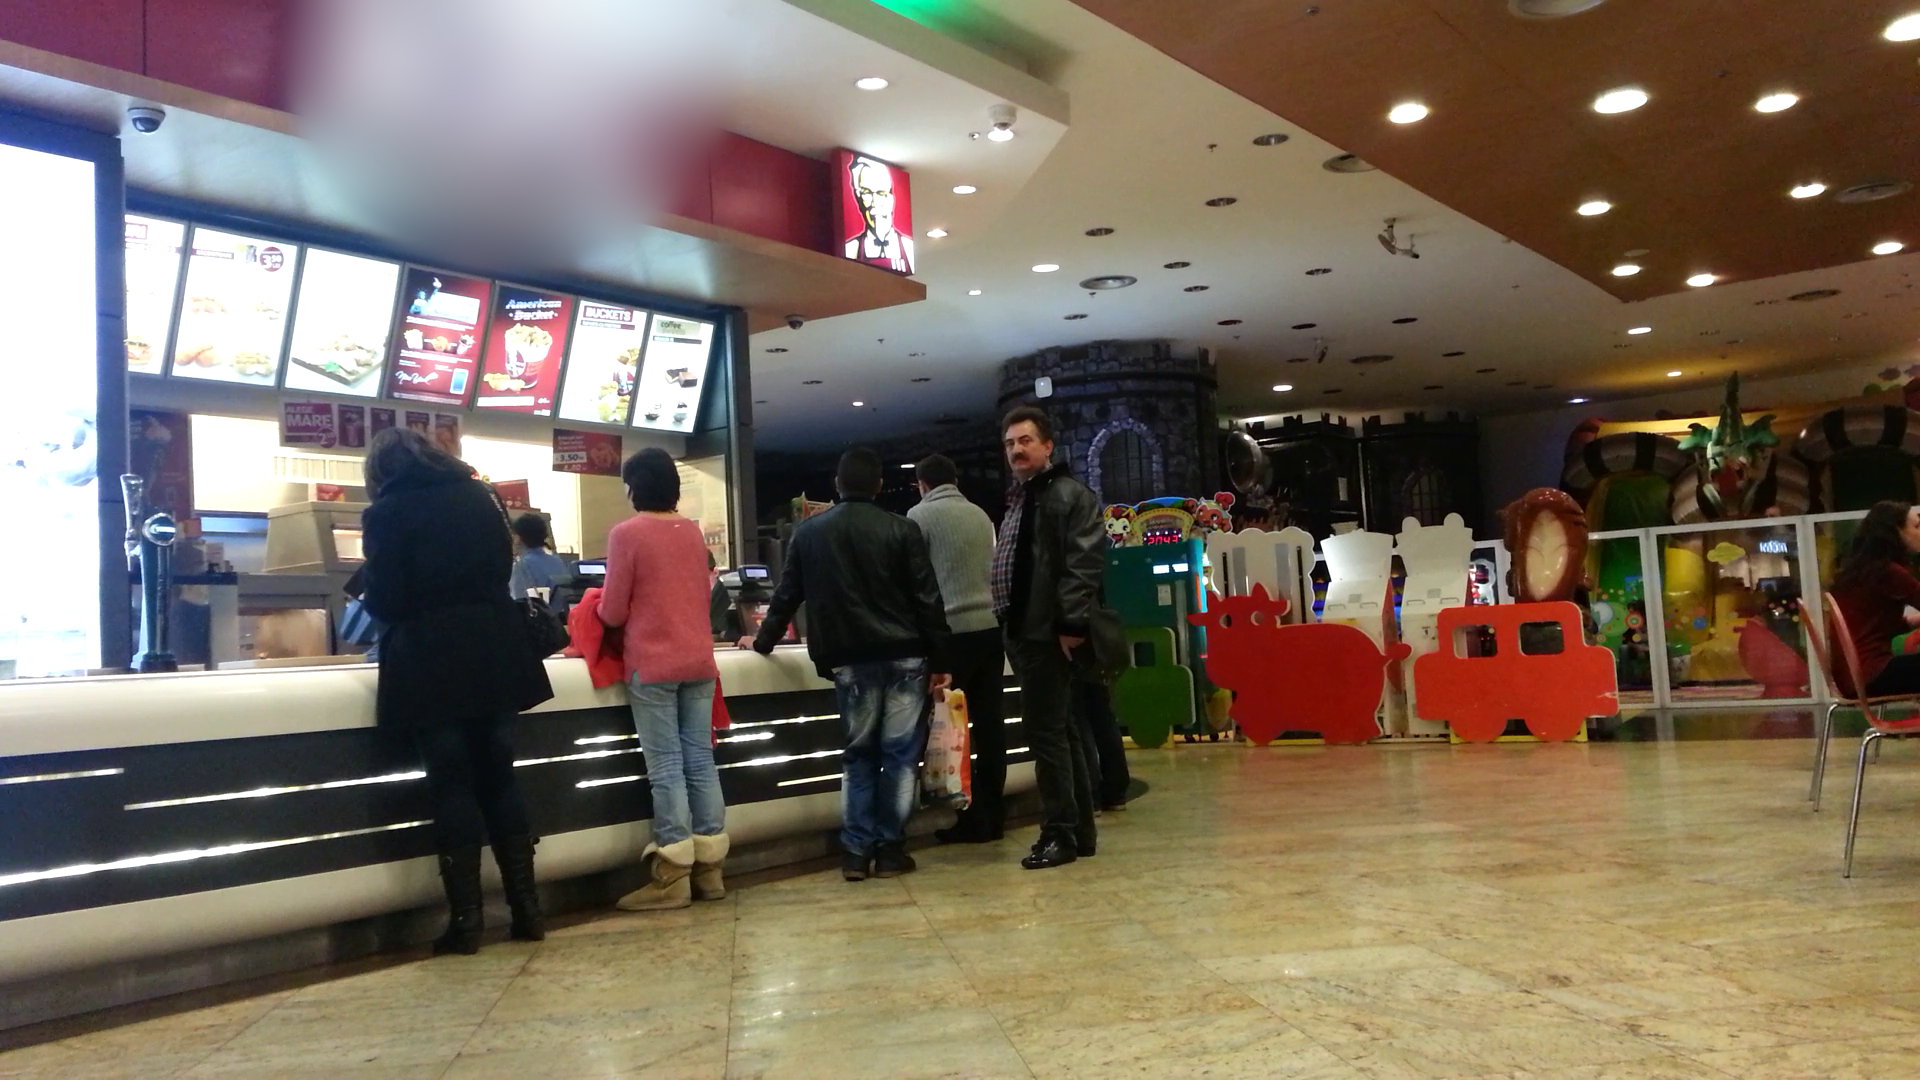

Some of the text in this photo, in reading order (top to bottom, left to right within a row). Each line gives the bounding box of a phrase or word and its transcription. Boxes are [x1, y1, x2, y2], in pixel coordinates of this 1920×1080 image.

[262, 255, 272, 269] 3
[585, 307, 632, 321] BUCKETS
[660, 320, 682, 330] coffee
[287, 413, 332, 428] MARE
